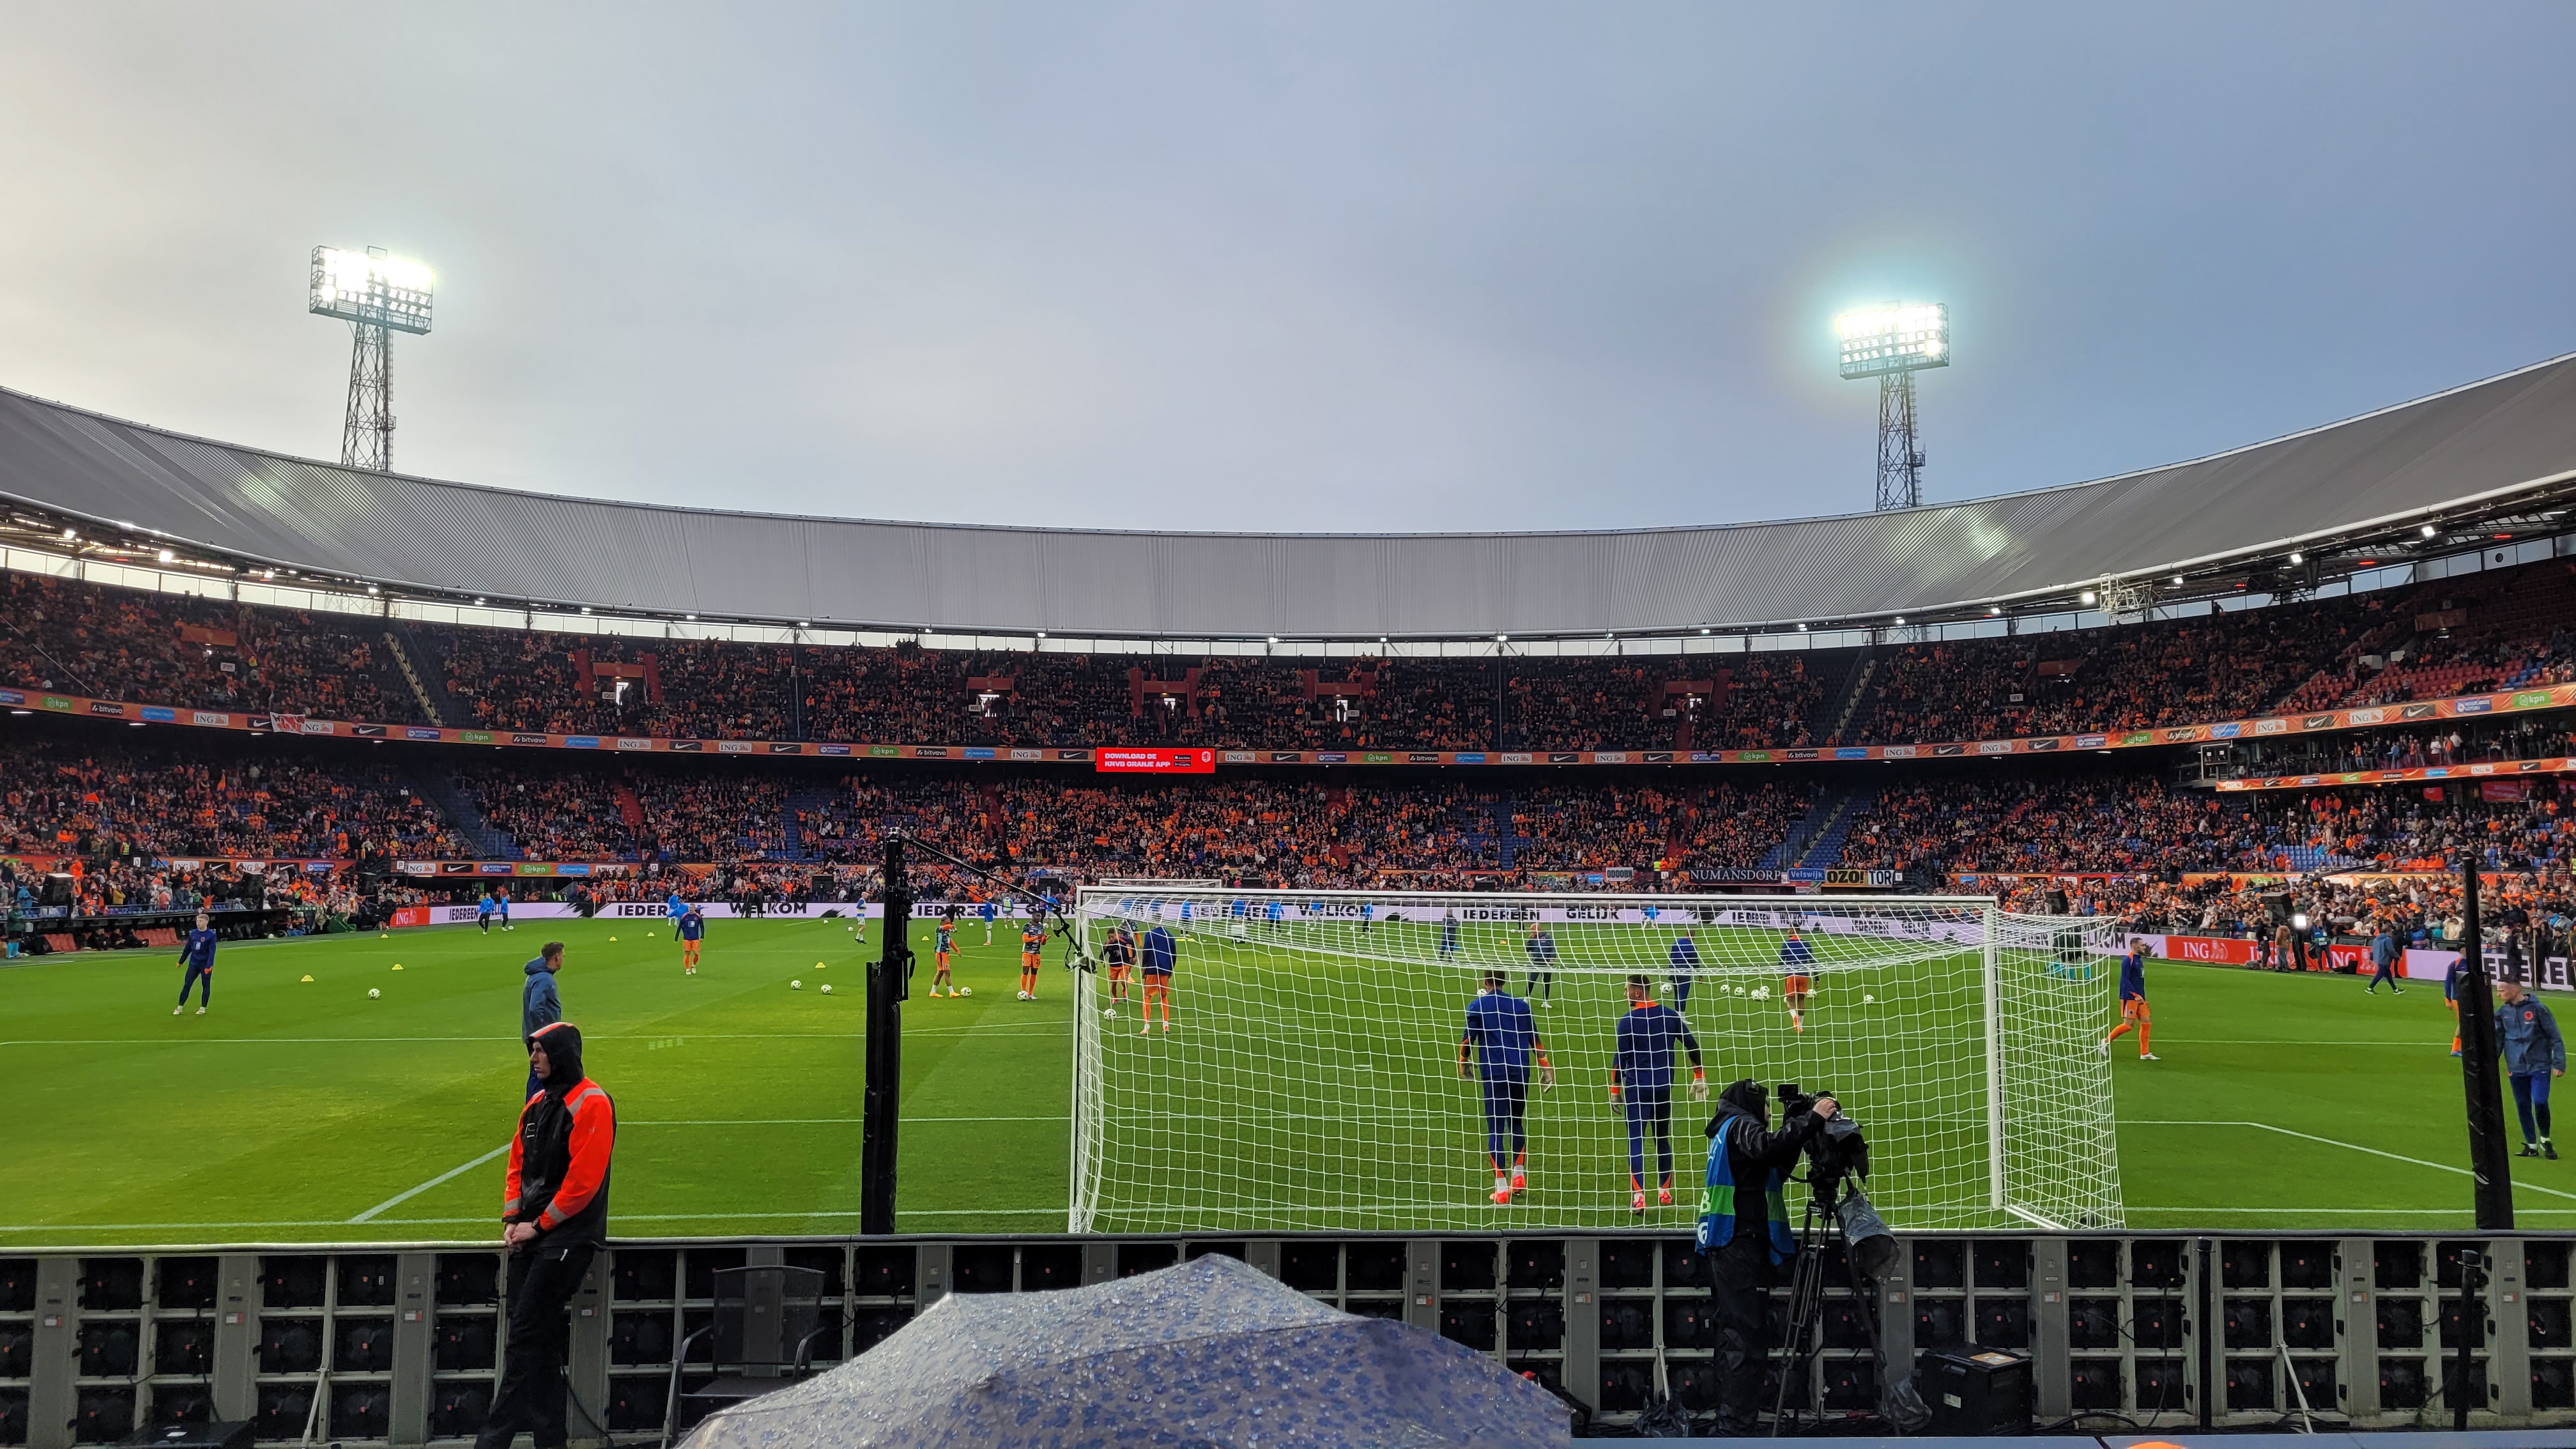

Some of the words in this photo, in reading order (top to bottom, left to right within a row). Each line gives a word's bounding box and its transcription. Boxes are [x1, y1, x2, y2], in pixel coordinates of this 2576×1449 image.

[55, 697, 68, 709] kpn
[2529, 693, 2545, 705] kpn
[99, 705, 123, 714] bitvavo
[195, 715, 213, 723] ING
[2352, 714, 2368, 723] ING
[475, 733, 488, 742] kpn
[1690, 870, 1781, 880] NUMANSDORP
[1791, 870, 1823, 879] Velswijk
[1827, 871, 1864, 883] OZO!
[1869, 870, 1892, 884] TOR
[395, 912, 409, 924] ING
[449, 907, 479, 921] IEDEREEN
[1463, 910, 1540, 920] IEDEREEN
[1566, 907, 1620, 920] GELIJK
[2083, 931, 2126, 949] ELKOM
[2183, 942, 2209, 958] ING
